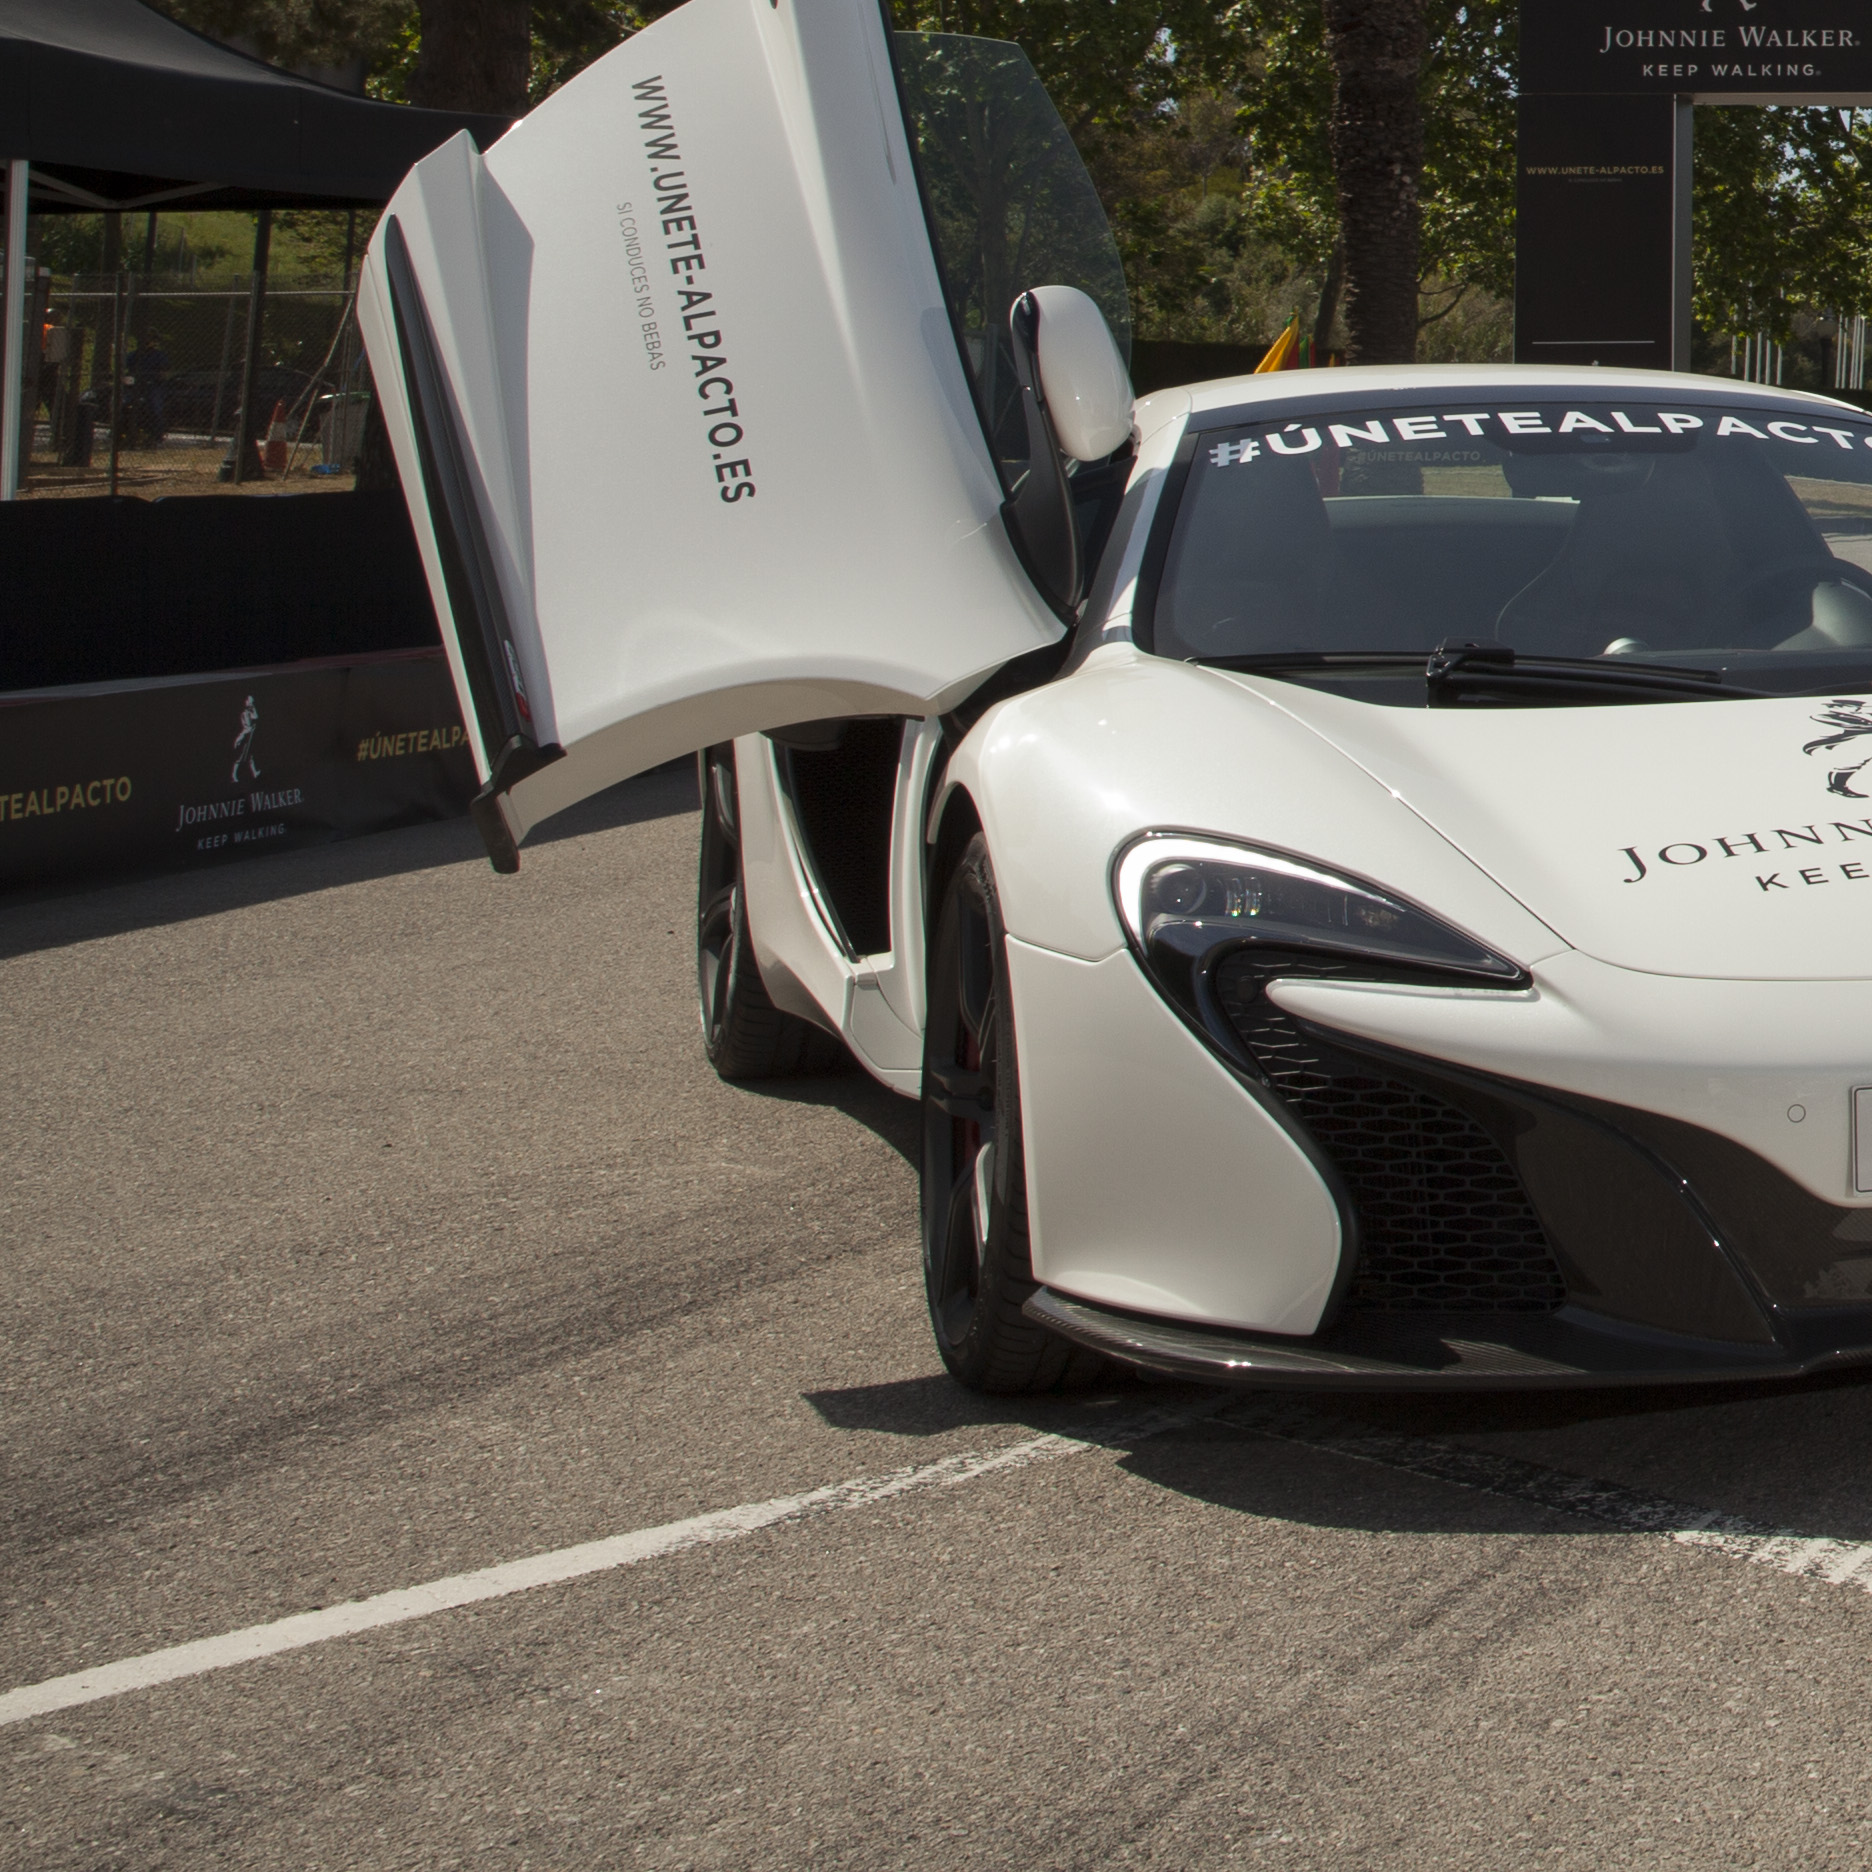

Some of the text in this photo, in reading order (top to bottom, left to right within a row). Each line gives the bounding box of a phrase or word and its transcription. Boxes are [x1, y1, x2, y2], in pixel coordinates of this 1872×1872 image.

[1600, 26, 1853, 53] JOHNNIE WALKER
[1643, 64, 1815, 77] KEEP WALKING
[1526, 166, 1664, 175] WWW.UNETE-ALPACTO.ES
[617, 202, 666, 371] SI CONDUCES NO BEBAS
[631, 74, 756, 504] WWW.UNETE-ALPACTO.ES
[176, 788, 302, 832] JOHNNIE WALKER
[198, 823, 285, 850] KEEP WALKING
